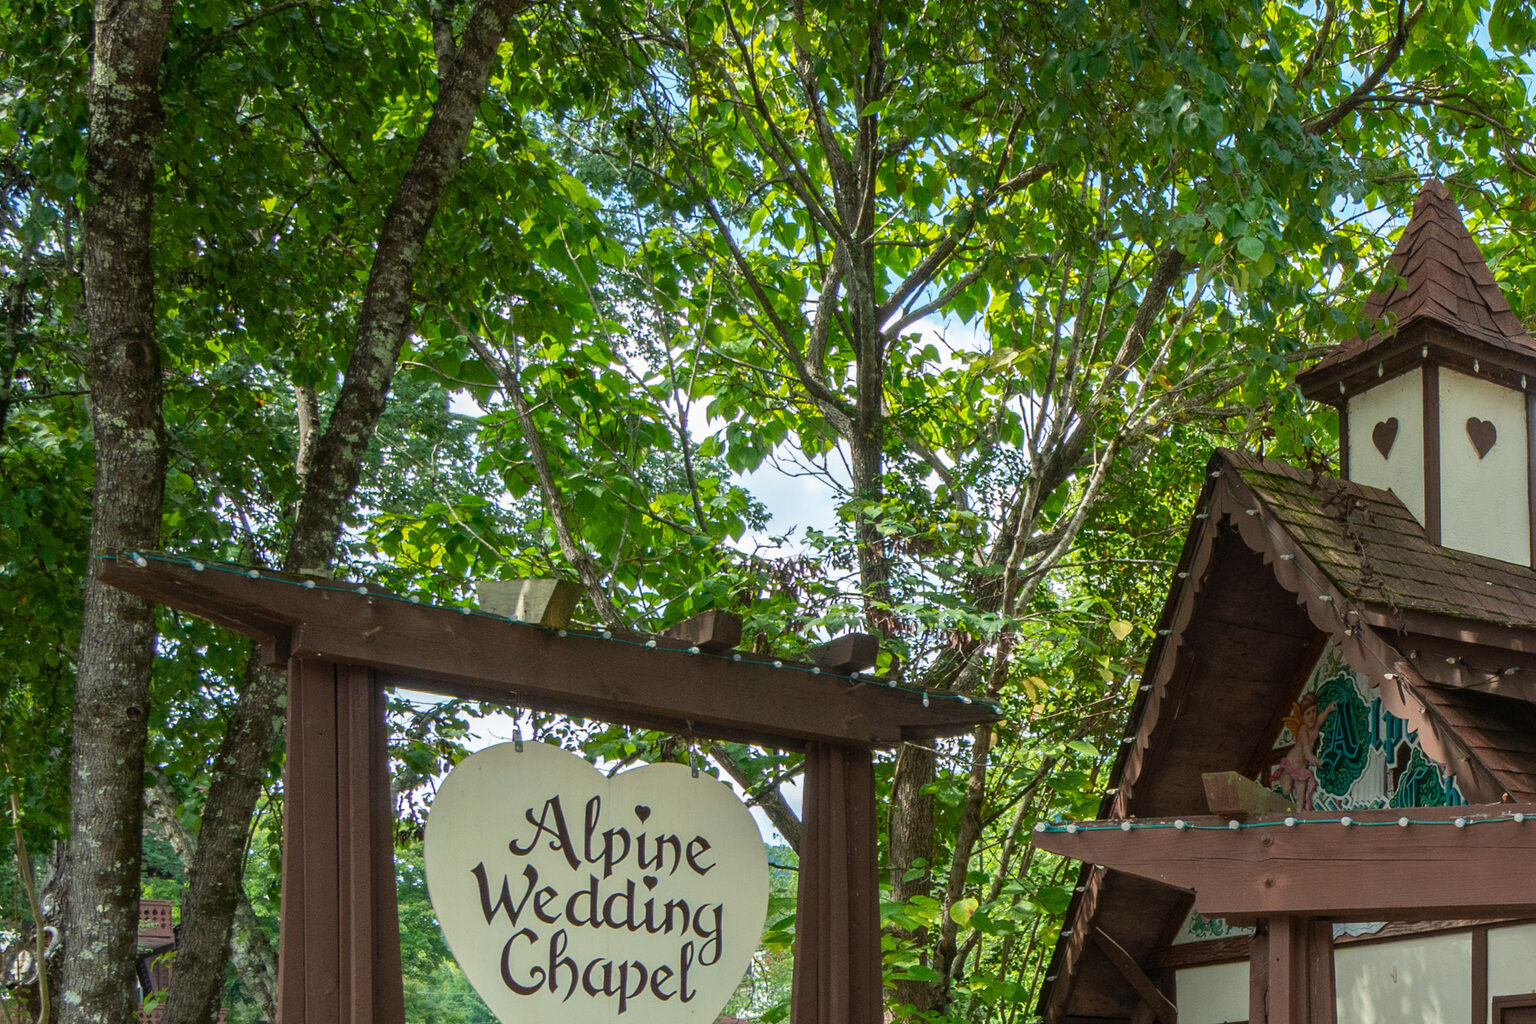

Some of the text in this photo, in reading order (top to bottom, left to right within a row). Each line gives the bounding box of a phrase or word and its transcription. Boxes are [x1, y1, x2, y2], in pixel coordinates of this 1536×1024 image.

[509, 794, 717, 879] Alpine
[471, 861, 724, 966] Wedding
[501, 927, 697, 1015] Chapel
